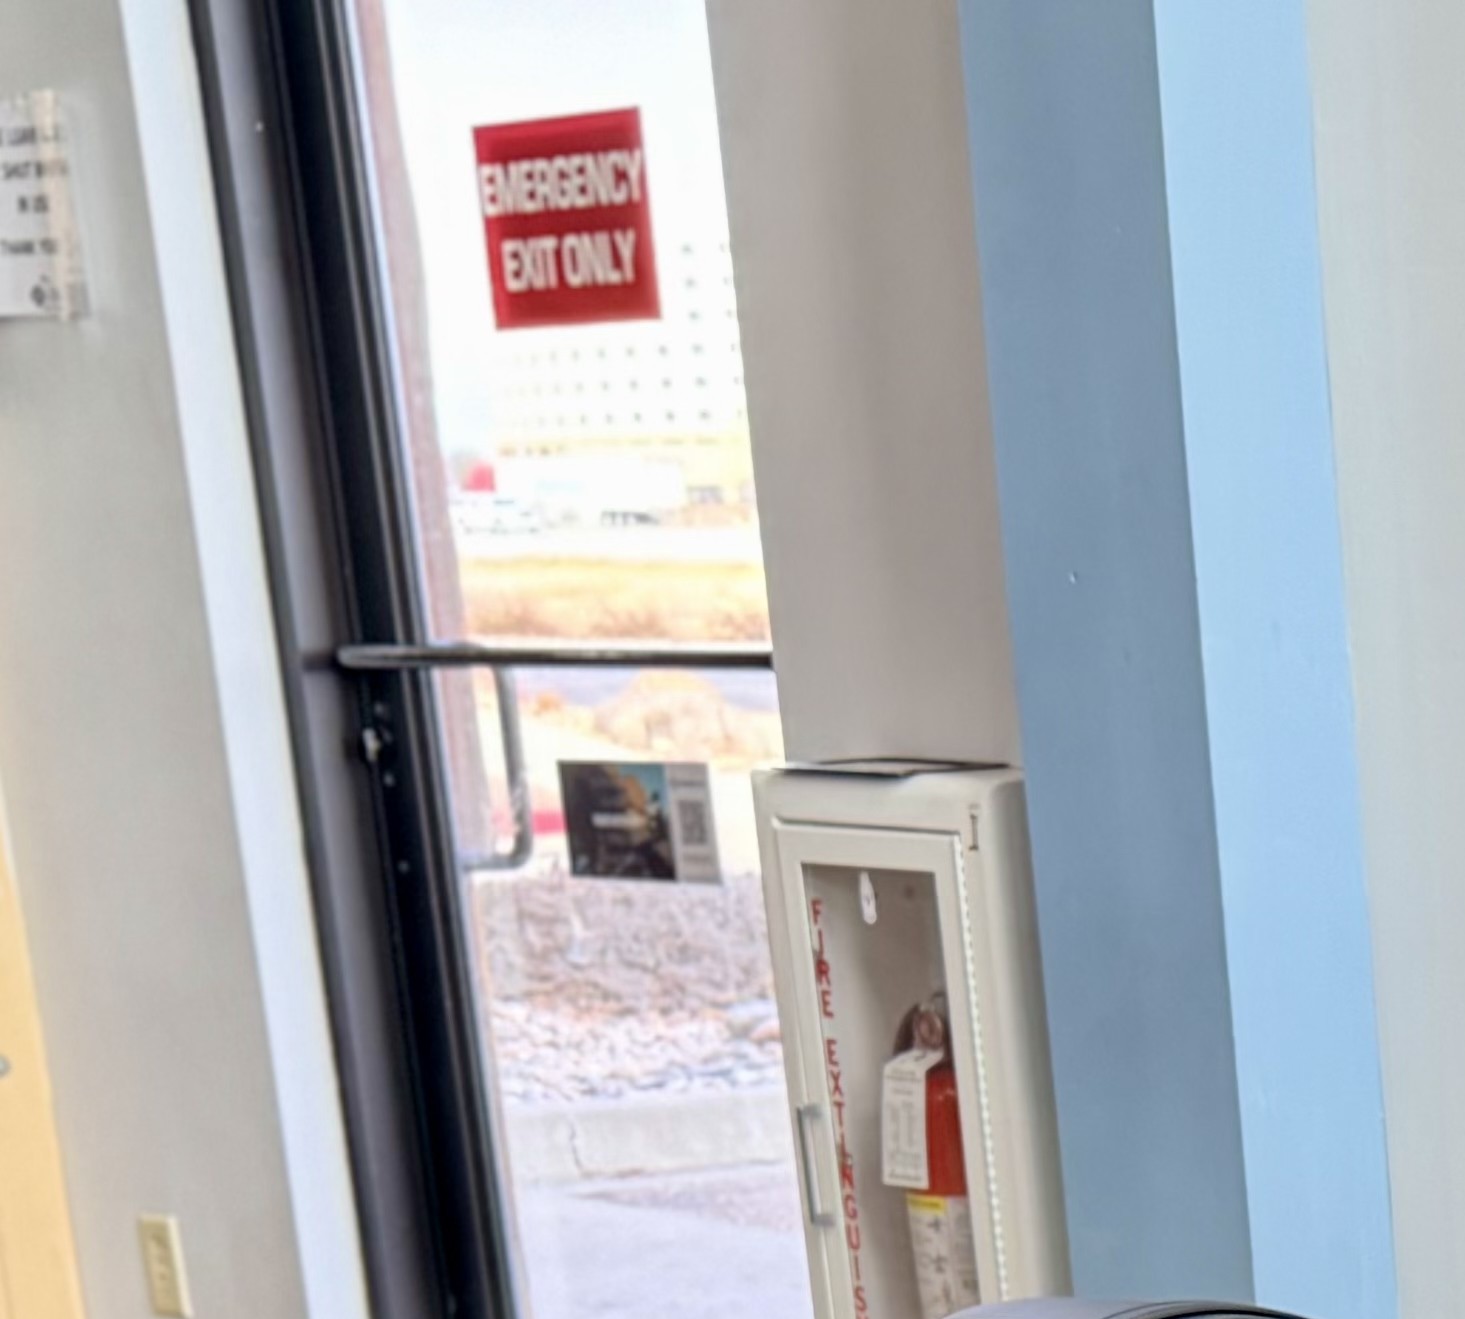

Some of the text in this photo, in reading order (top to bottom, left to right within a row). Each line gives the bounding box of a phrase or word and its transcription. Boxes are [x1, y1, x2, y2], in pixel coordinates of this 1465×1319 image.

[479, 148, 643, 217] EMERGENCY
[501, 227, 637, 293] EXIT ONLY
[812, 898, 835, 1019] FIRE
